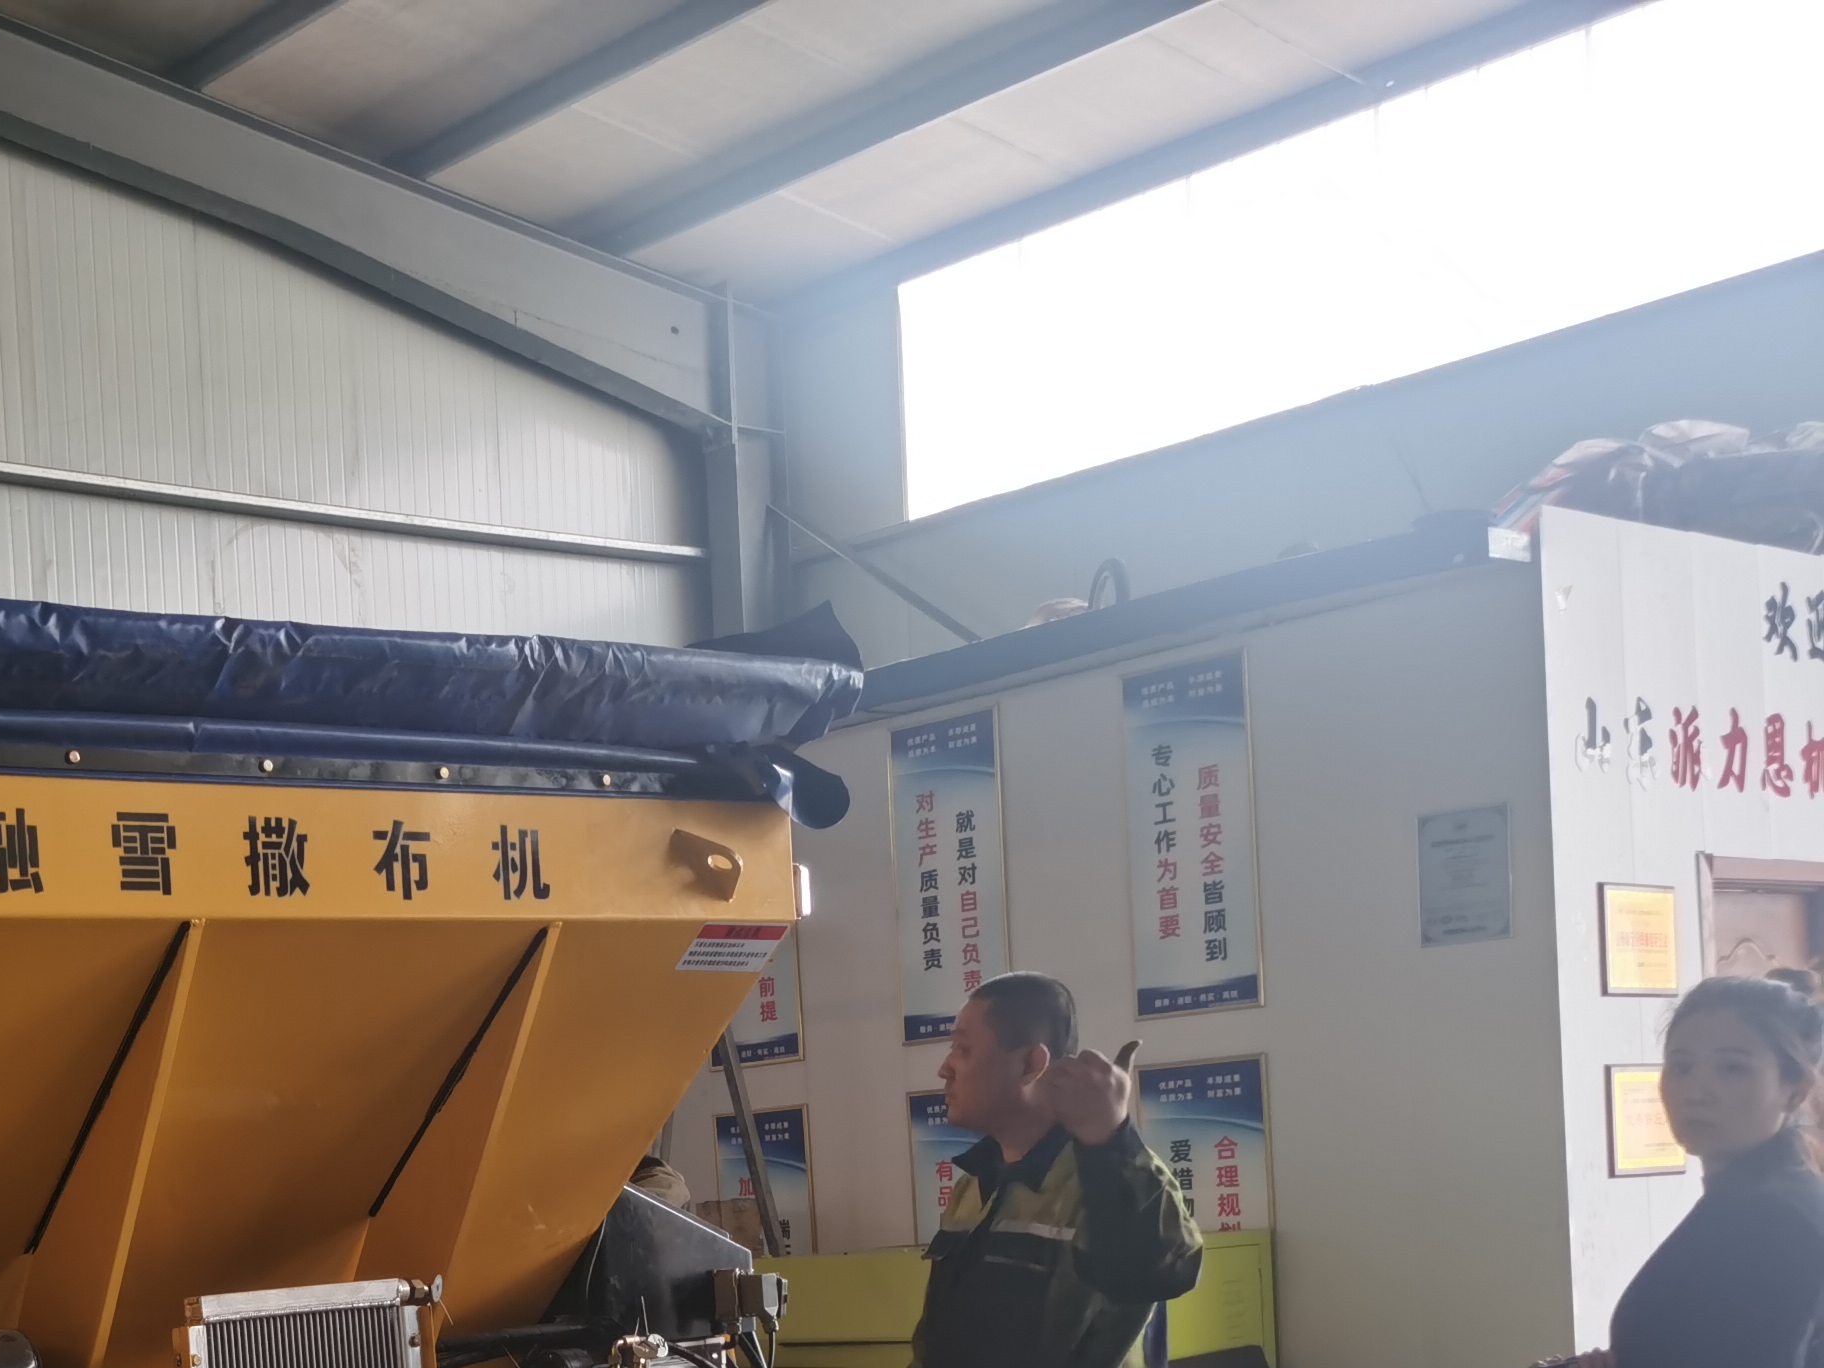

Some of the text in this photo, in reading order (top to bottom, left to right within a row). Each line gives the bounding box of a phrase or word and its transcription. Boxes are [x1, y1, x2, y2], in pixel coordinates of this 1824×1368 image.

[916, 791, 943, 971] 对生产质量负责
[955, 809, 982, 993] 就是对自己负责
[1151, 745, 1181, 940] 专心工作为首要
[1197, 764, 1227, 962] 质量安全皆顾到
